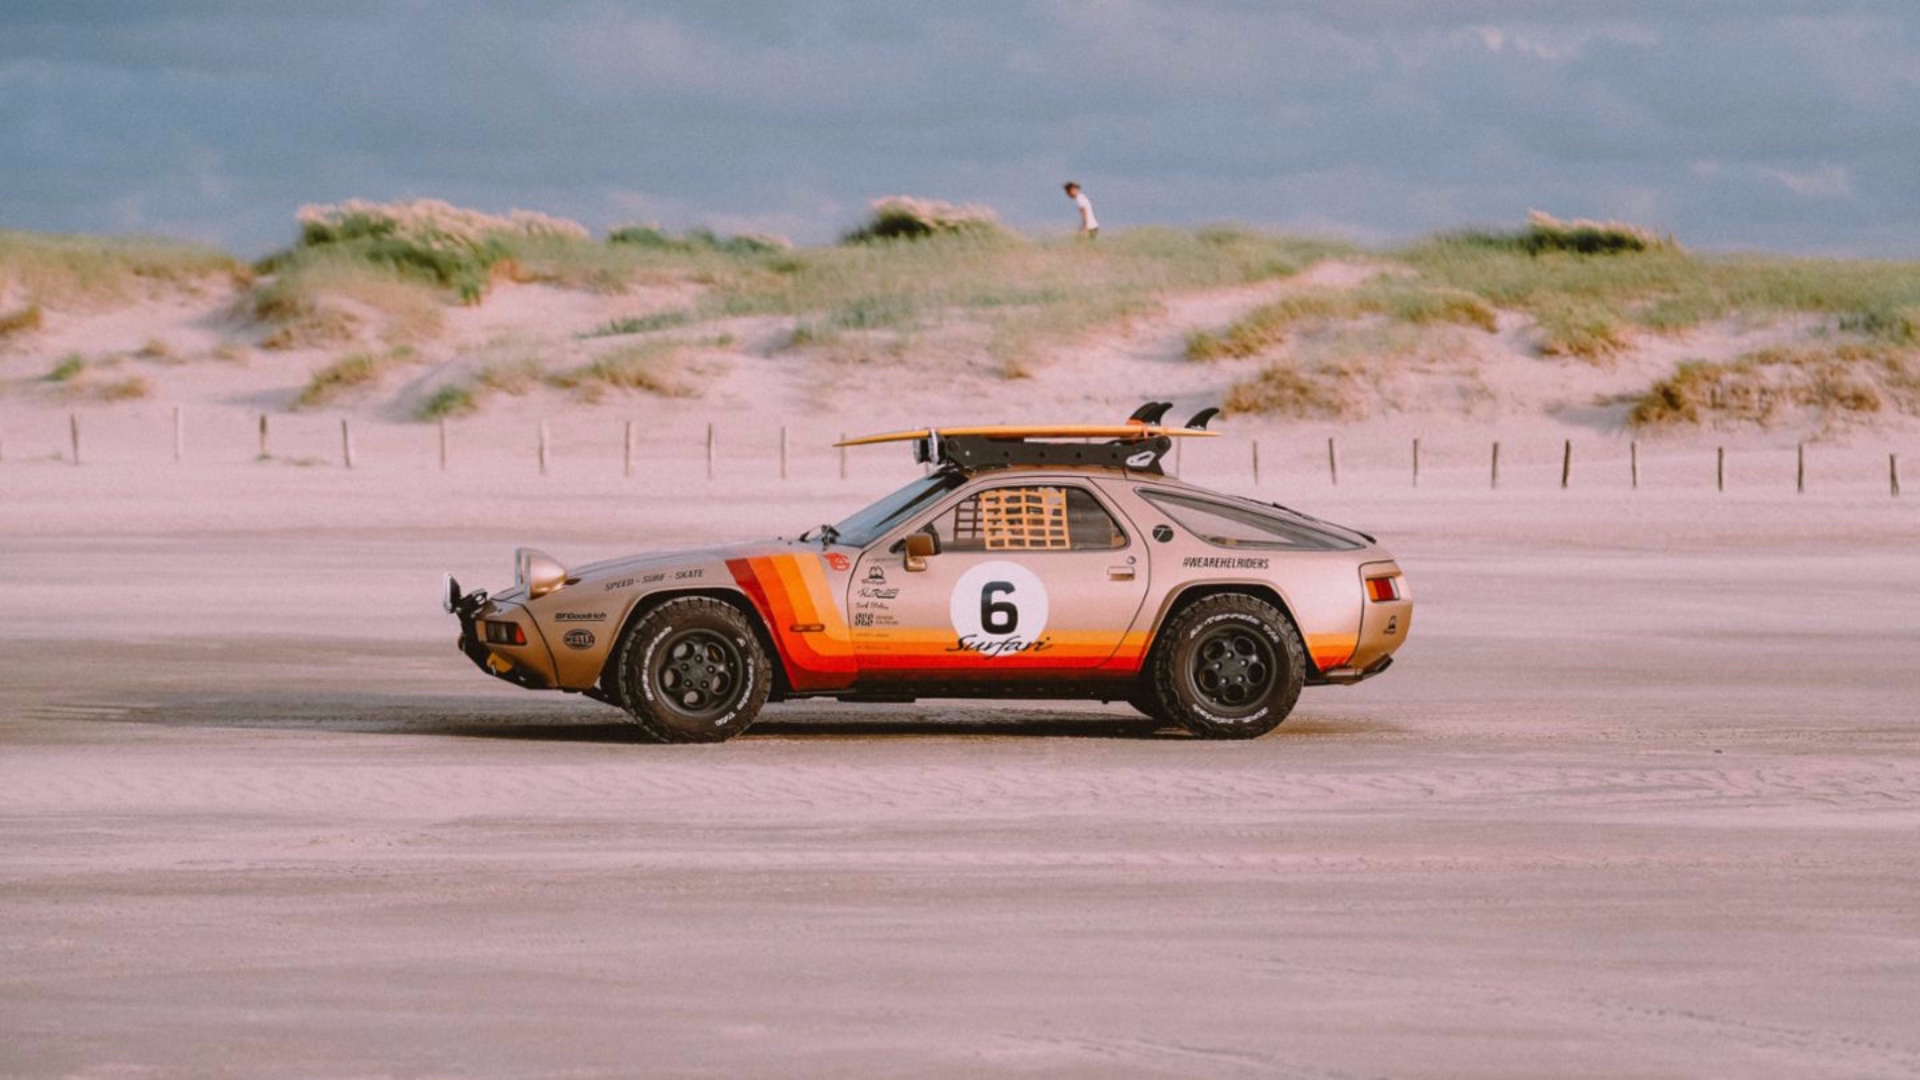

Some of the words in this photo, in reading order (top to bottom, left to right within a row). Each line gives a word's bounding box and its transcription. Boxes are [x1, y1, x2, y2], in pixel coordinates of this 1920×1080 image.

[1182, 557, 1269, 569] #WEAREHELRIDERS
[604, 578, 634, 591] SPEED
[641, 573, 666, 583] SURF
[675, 568, 704, 579] SKATE
[555, 611, 607, 620] BFGoodrich
[981, 581, 1018, 635] 6
[565, 632, 595, 647] HELLA
[945, 634, 1054, 660] Surfari
